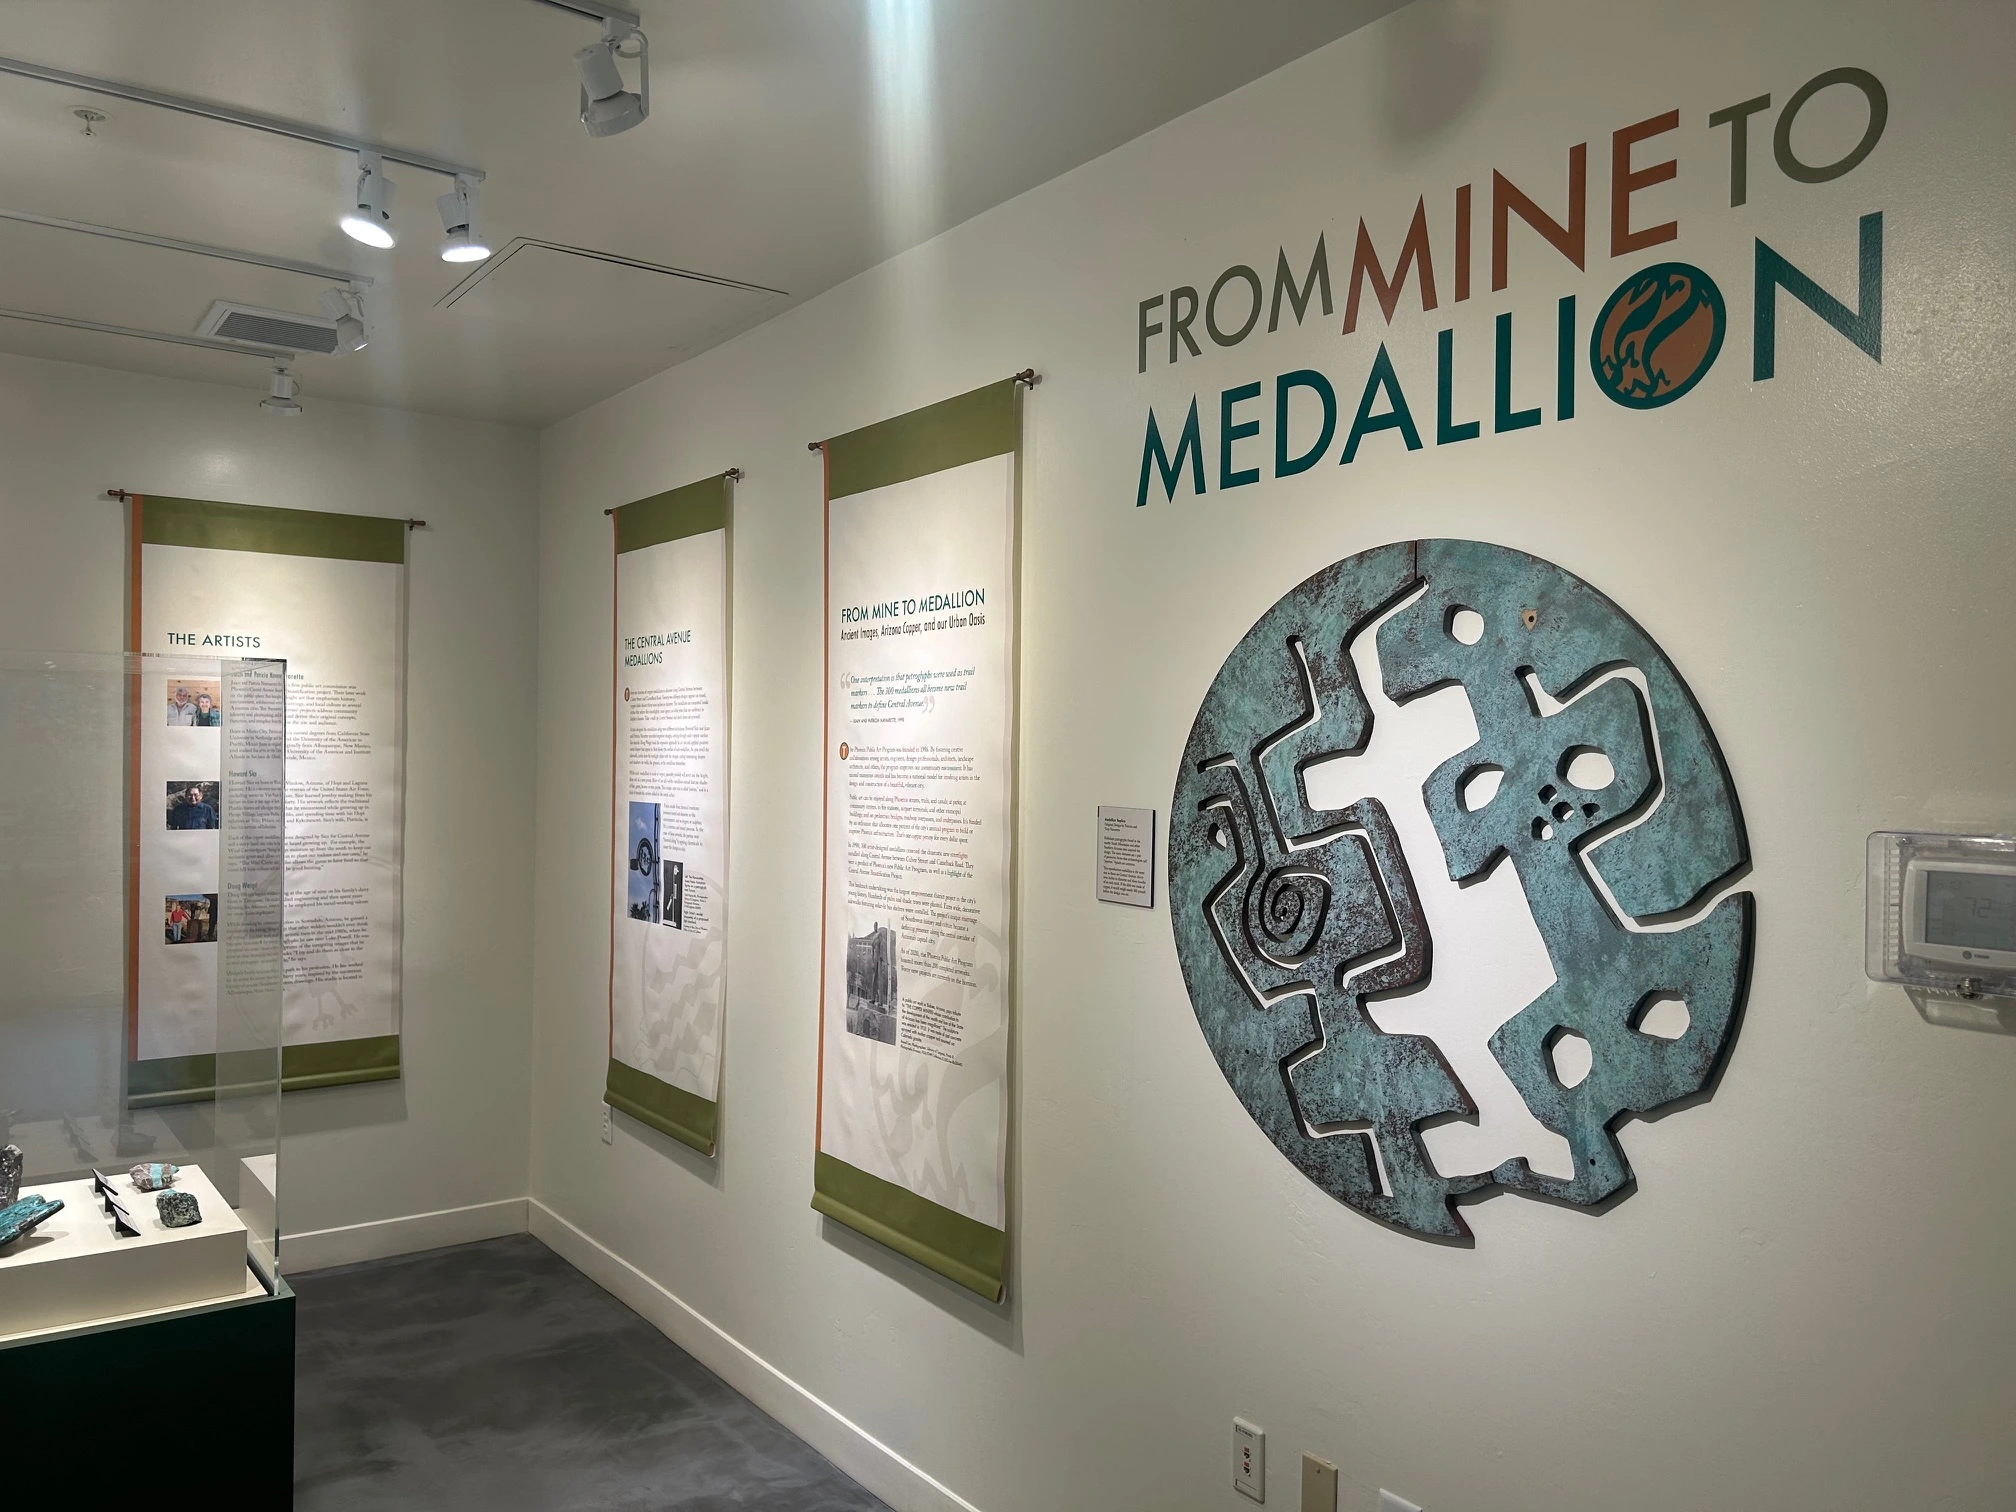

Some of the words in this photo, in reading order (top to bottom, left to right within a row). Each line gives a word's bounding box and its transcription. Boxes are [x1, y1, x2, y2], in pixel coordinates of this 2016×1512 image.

[1138, 231, 1334, 374] FROM
[1342, 108, 1680, 336] MINE
[1708, 67, 1888, 207] TO
[1136, 211, 1883, 508] MEDALLION
[841, 606, 868, 623] FROM
[872, 601, 899, 619] MINE
[902, 599, 916, 615] TO
[919, 588, 985, 614] MEDALLION
[167, 633, 195, 645] THE
[202, 634, 260, 648] ARTISTS
[625, 638, 635, 650] THE
[637, 634, 664, 648] CENTRAL
[666, 630, 691, 645] AVENUE
[841, 629, 859, 641] Ancient
[860, 627, 879, 641] Images,
[881, 625, 901, 636] Arizona
[903, 621, 922, 636] Copper,
[924, 617, 935, 631] and
[937, 620, 947, 630] our
[949, 614, 967, 629] Urban
[969, 612, 985, 626] Oasis
[625, 652, 662, 667] MEDALLIONS
